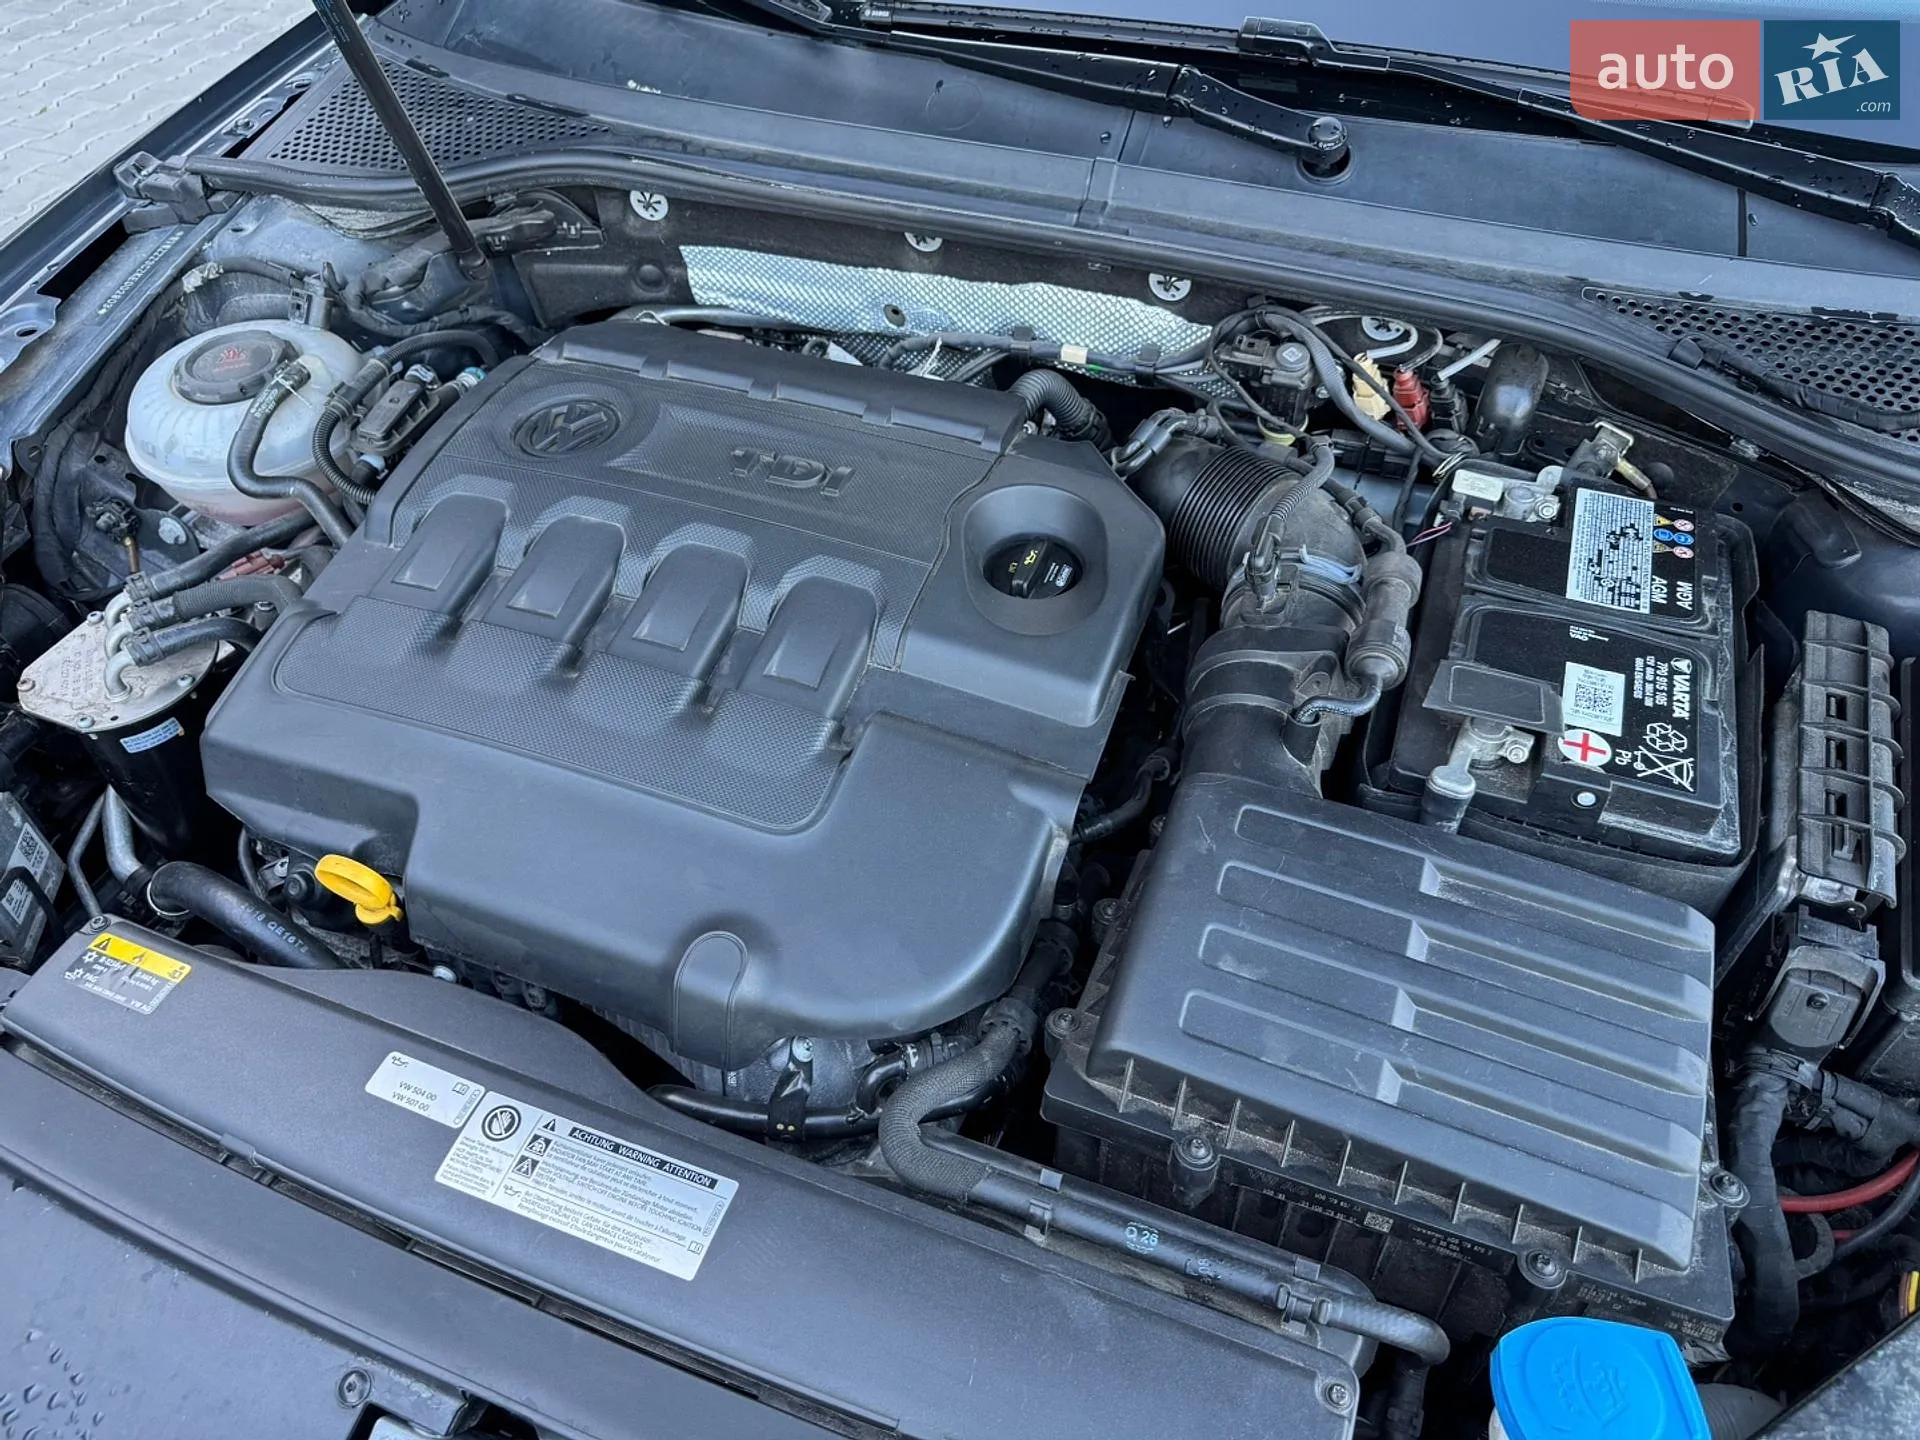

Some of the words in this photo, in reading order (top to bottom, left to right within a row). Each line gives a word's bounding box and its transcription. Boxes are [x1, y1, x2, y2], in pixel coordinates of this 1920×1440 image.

[731, 448, 855, 497] TDI
[1651, 575, 1668, 605] AGM
[1676, 581, 1693, 610] AGM
[1672, 674, 1691, 719] VARTA
[1615, 749, 1632, 766] Pb
[390, 1090, 406, 1101] VW
[417, 1102, 430, 1112] 00
[397, 1080, 413, 1091] VW
[411, 1086, 427, 1096] 504
[424, 1091, 438, 1102] 00
[571, 1128, 615, 1151] ACHTUNG
[616, 1145, 661, 1168] WARNING
[661, 1161, 712, 1186] ATTENTION
[1140, 1230, 1160, 1247] 26
